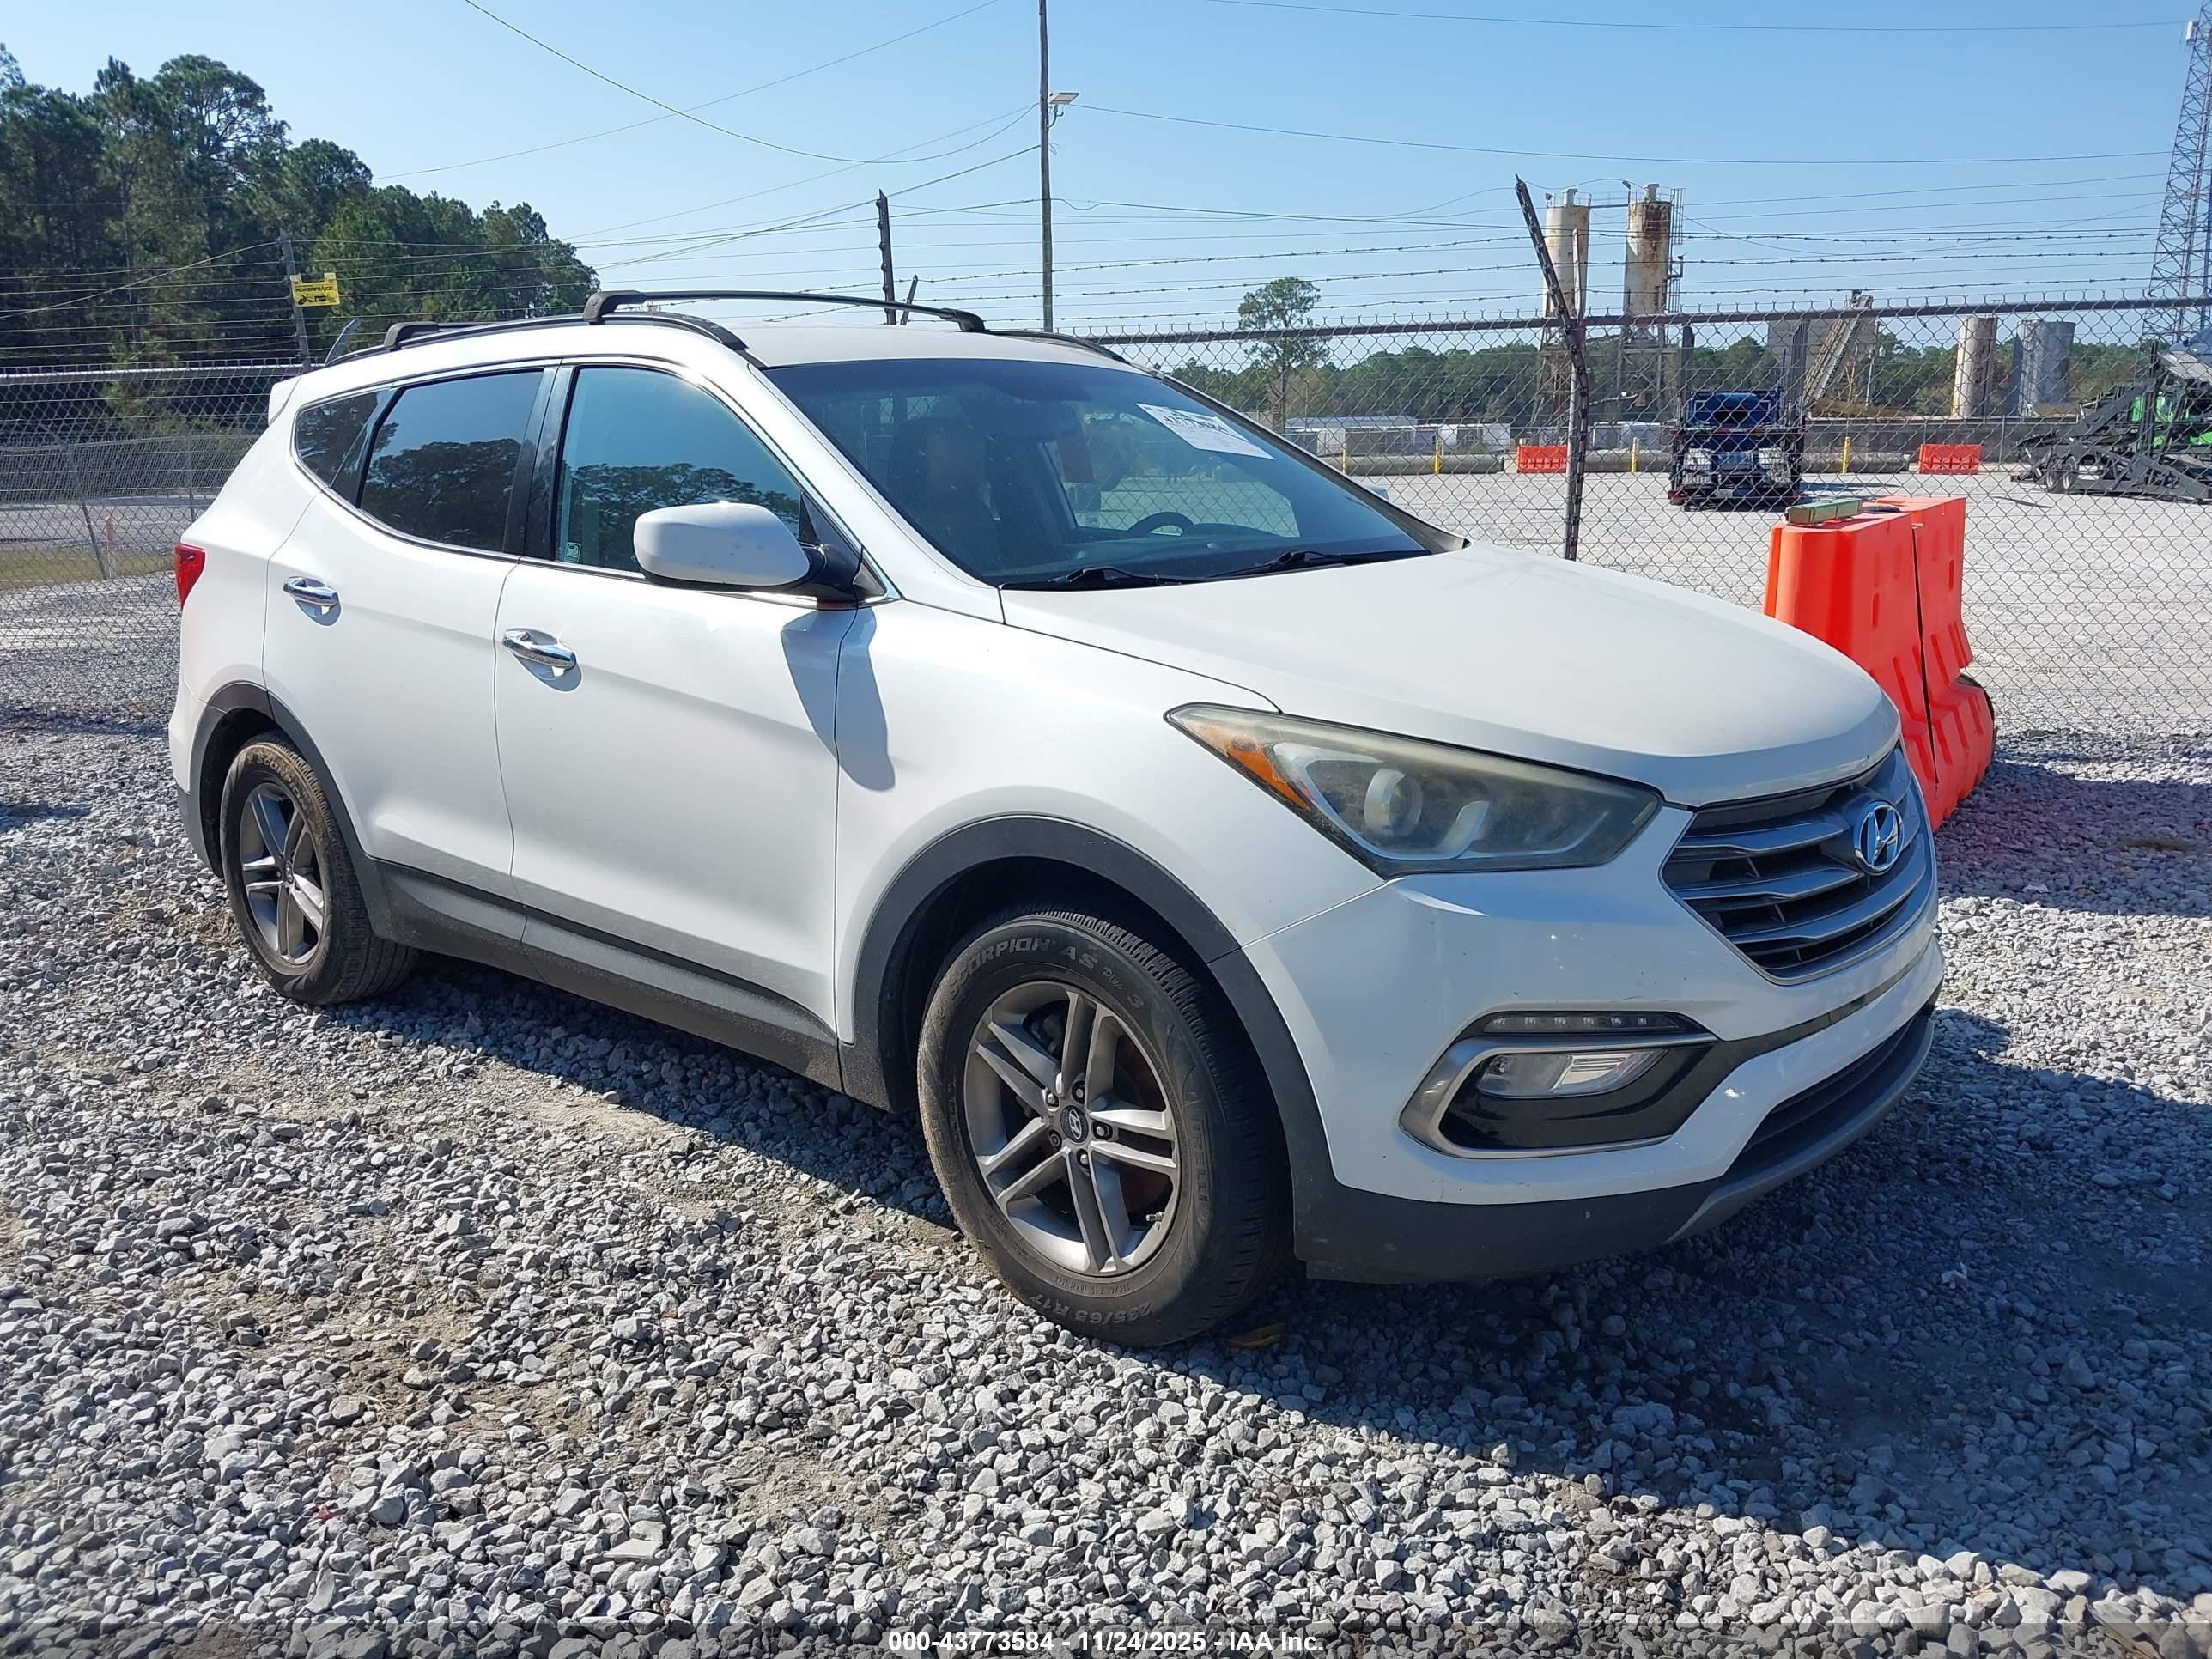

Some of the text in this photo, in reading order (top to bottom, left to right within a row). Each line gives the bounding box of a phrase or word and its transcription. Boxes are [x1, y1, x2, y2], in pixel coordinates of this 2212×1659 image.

[948, 937, 1051, 1001] SCORPION
[1127, 993, 1145, 1009] 3
[1074, 1301, 1152, 1326] 235/65
